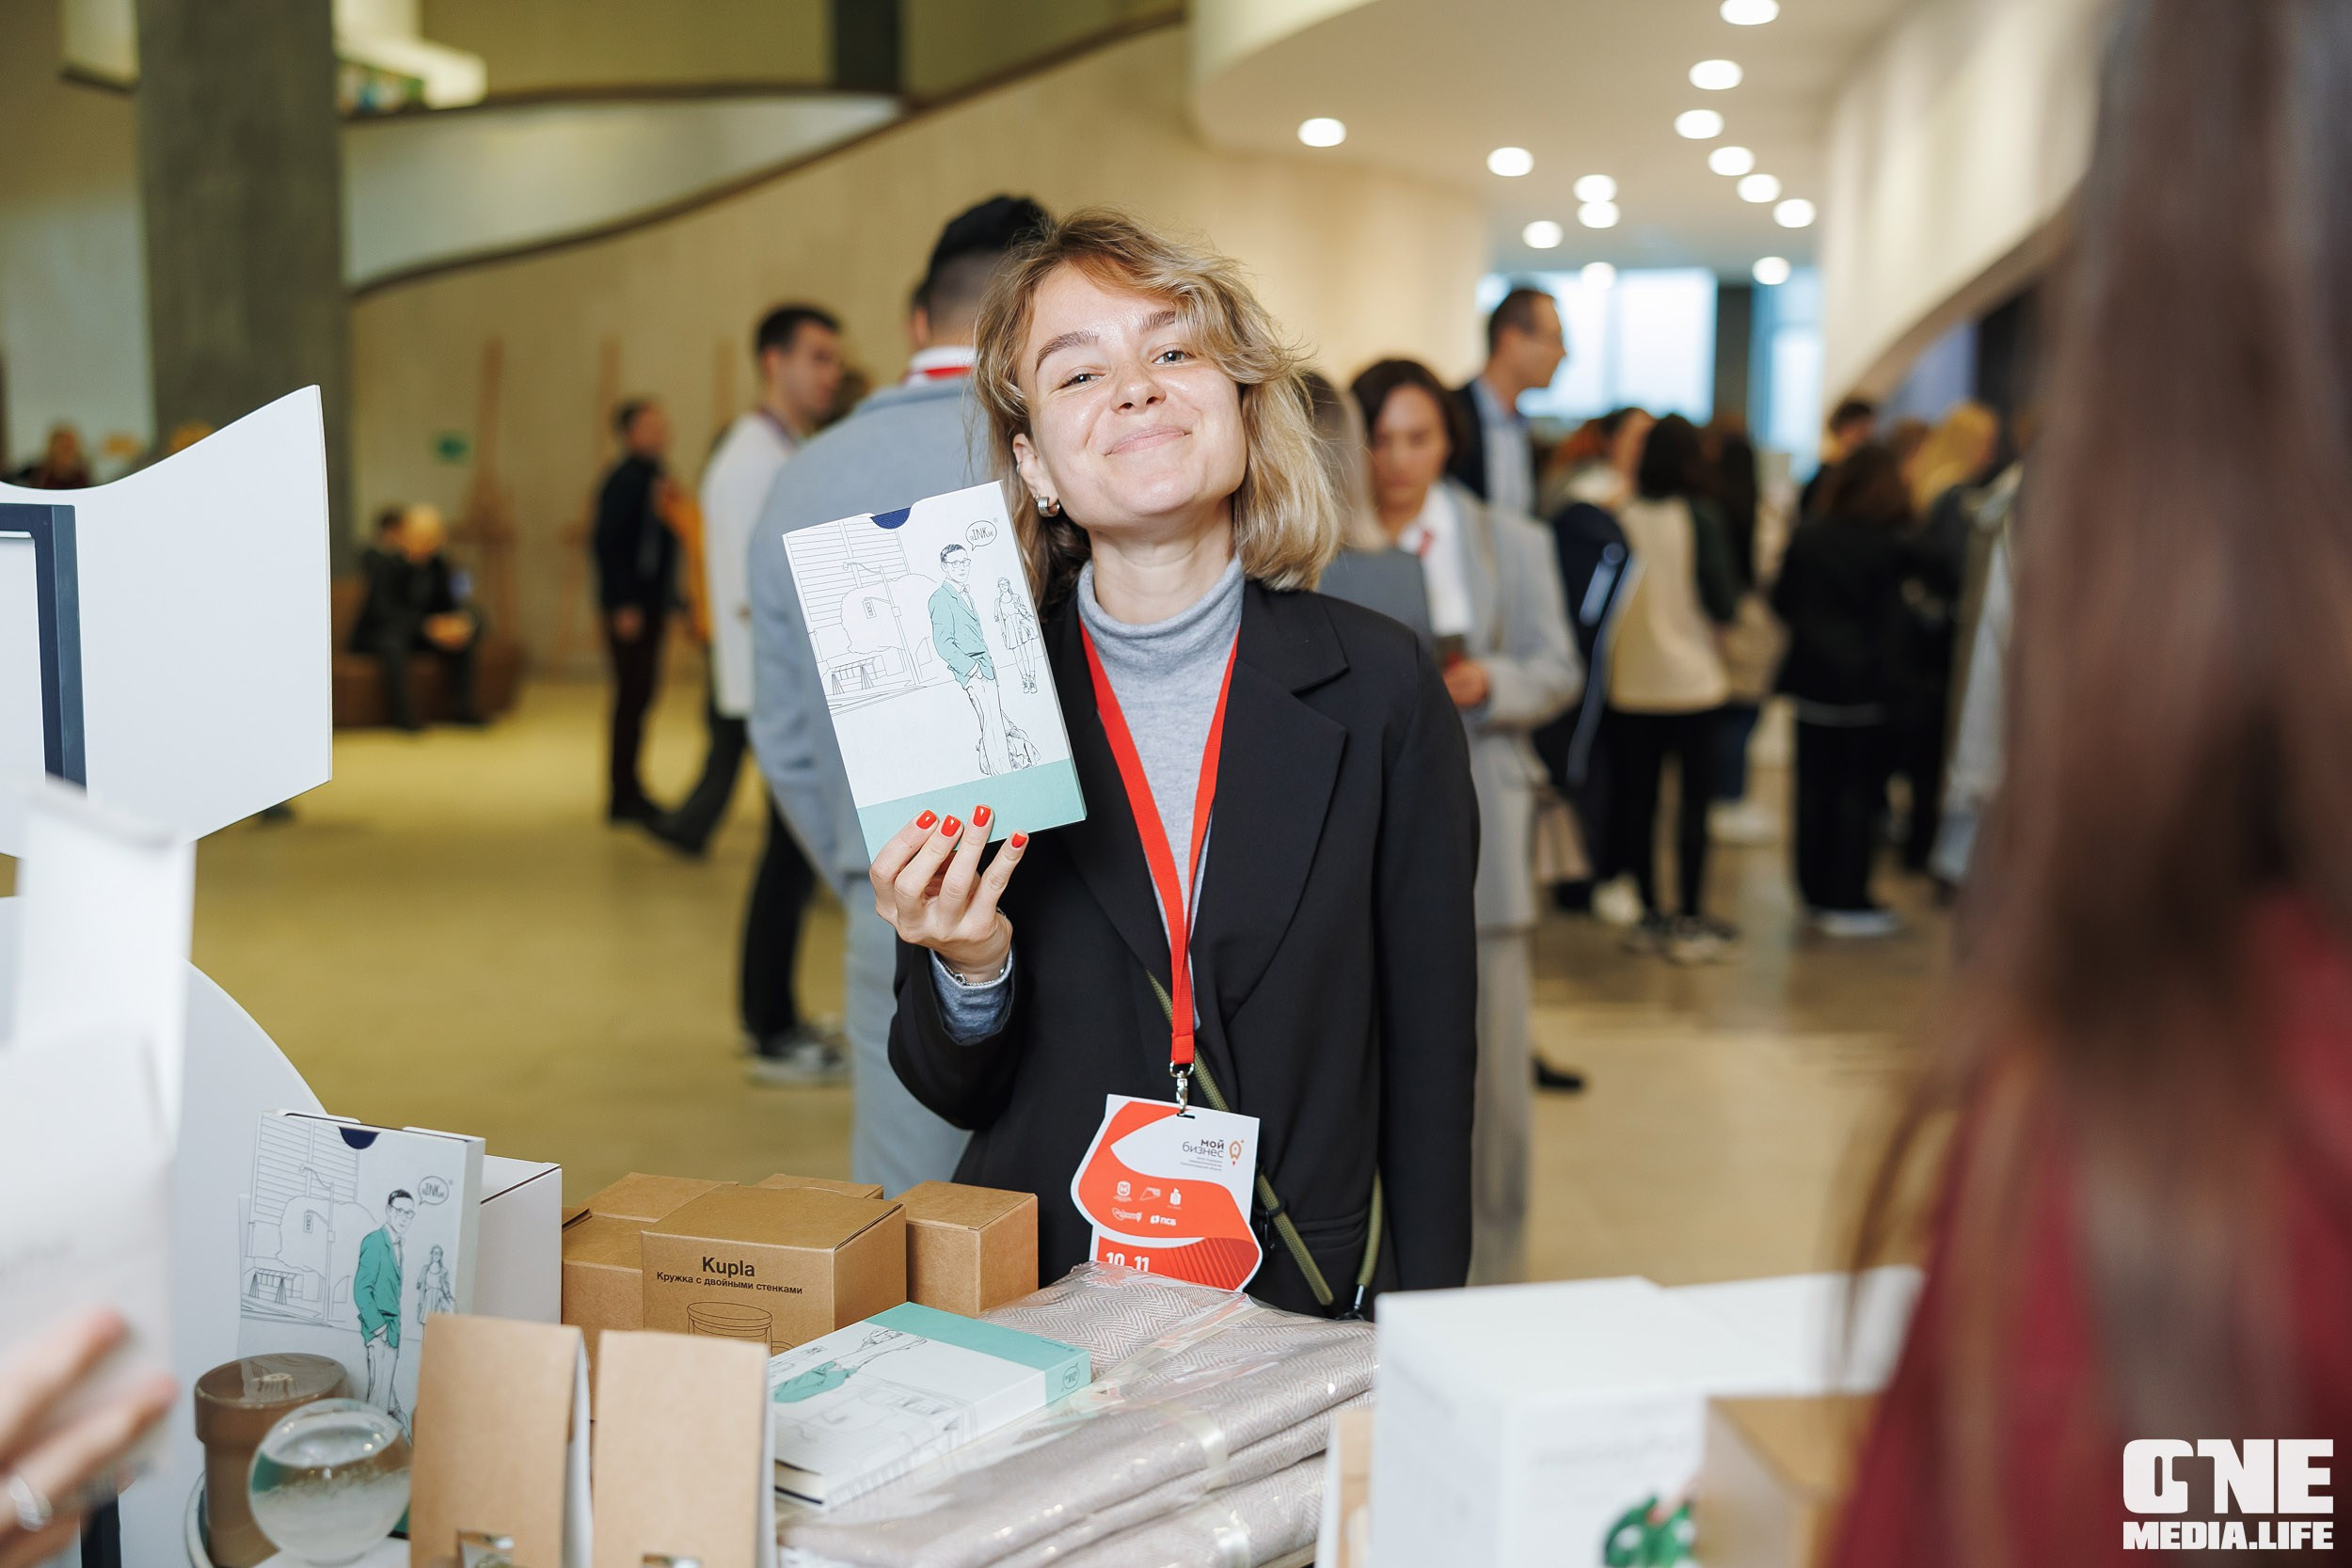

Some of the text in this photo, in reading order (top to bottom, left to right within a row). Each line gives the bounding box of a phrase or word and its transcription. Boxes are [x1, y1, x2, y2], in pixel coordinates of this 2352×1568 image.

[1182, 1141, 1224, 1158] бизнес
[1200, 1139, 1224, 1149] мой
[702, 1256, 755, 1278] Kupla
[657, 1271, 693, 1284] Кружка
[704, 1277, 754, 1290] двойными
[755, 1283, 803, 1294] стенками
